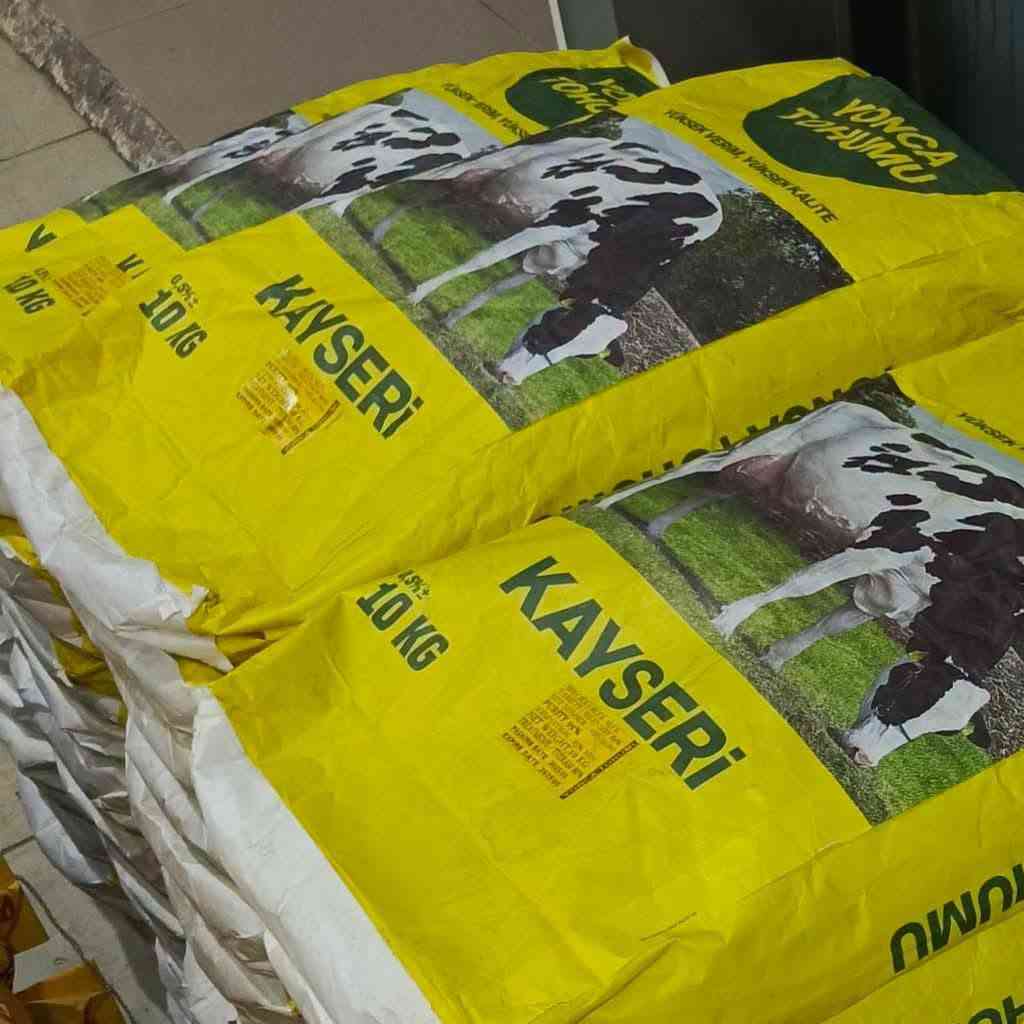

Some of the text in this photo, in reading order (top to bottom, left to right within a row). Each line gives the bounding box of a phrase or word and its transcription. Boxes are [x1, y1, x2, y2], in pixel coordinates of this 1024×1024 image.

[777, 107, 938, 184] TOHUMU
[833, 99, 959, 168] YONCA
[139, 288, 208, 359] 10 KG
[356, 583, 449, 671] 10 KG
